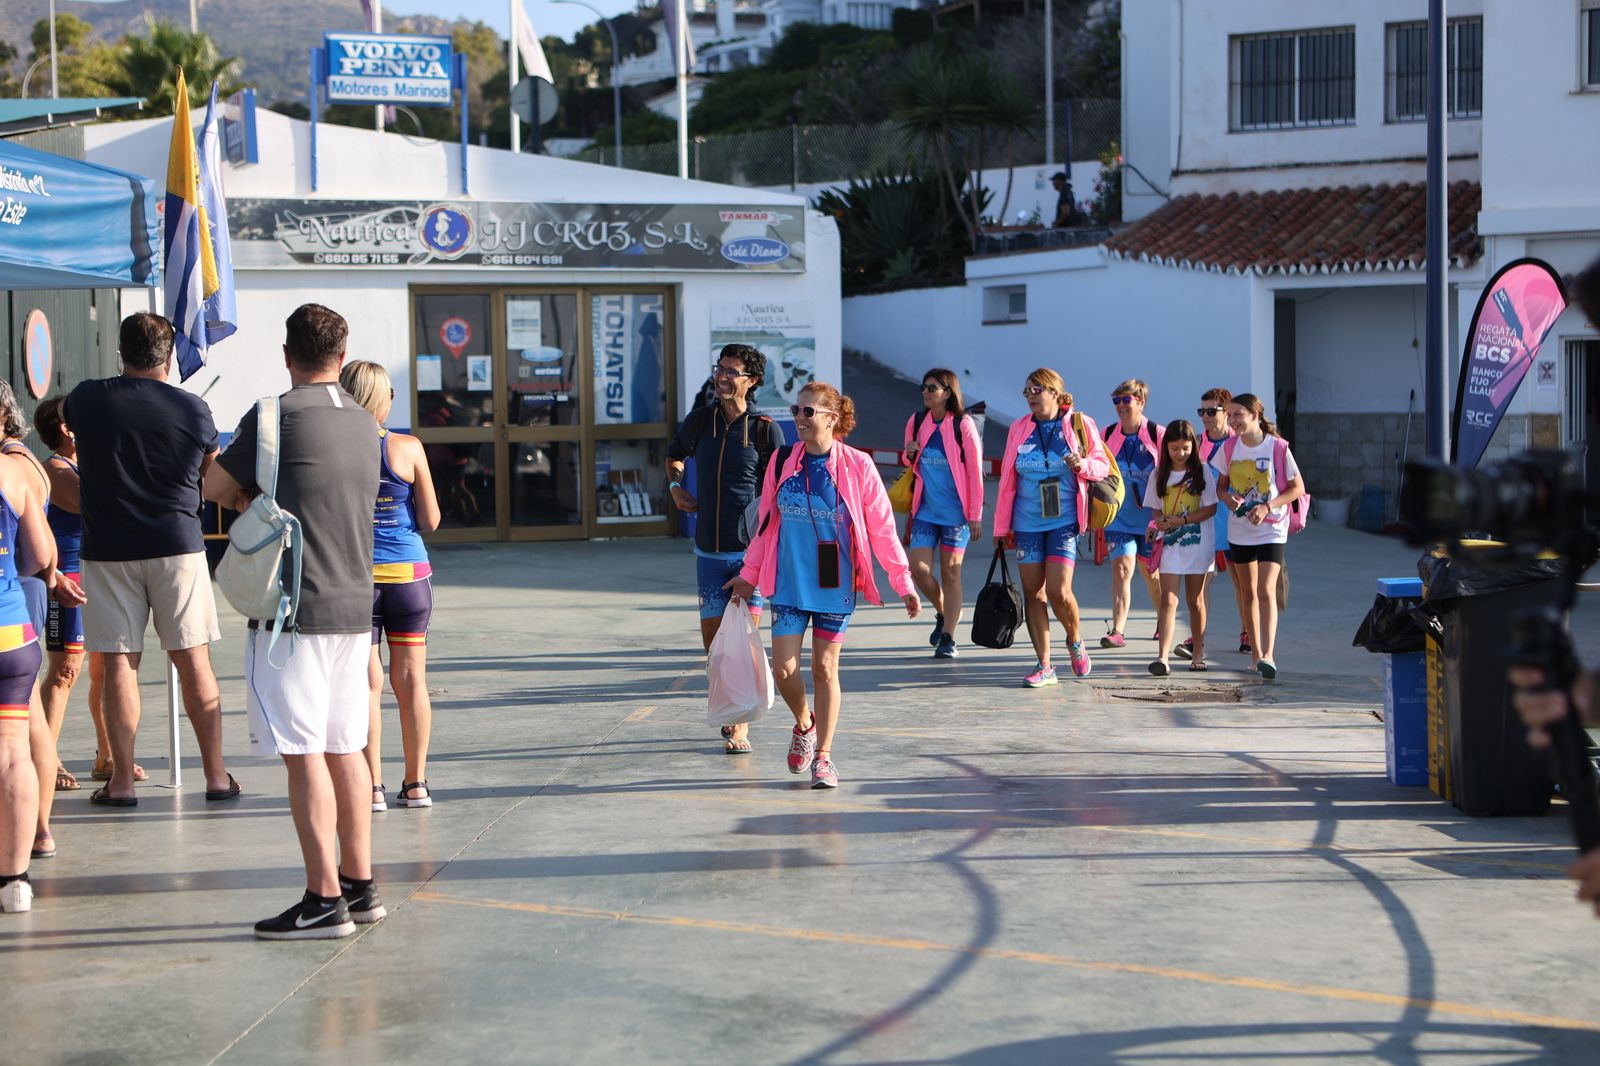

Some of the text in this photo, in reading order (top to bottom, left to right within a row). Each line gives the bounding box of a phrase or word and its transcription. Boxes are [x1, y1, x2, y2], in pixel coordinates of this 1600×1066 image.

[339, 41, 441, 61] VOLVO
[339, 58, 448, 78] PENTA
[332, 80, 448, 98] Motores Marinos
[1, 196, 28, 225] Este
[719, 211, 769, 221] YANMAR
[299, 217, 414, 249] Nautica
[750, 243, 782, 258] Diesel
[325, 253, 350, 264] 660
[369, 253, 380, 264] 71
[382, 253, 399, 264] 55
[492, 255, 513, 265] 651
[515, 255, 540, 265] 604
[741, 303, 784, 316] Nautica
[1480, 323, 1517, 337] REGATA
[1478, 333, 1525, 350] NACIONAL
[605, 295, 625, 419] TOHATSU
[1475, 344, 1511, 364] BCS
[1472, 366, 1503, 379] BANCO
[1470, 376, 1489, 386] FIJO
[1469, 386, 1496, 397] LLAUT
[777, 503, 808, 516] ticas
[50, 608, 59, 617] DE
[50, 617, 59, 638] CLUB
